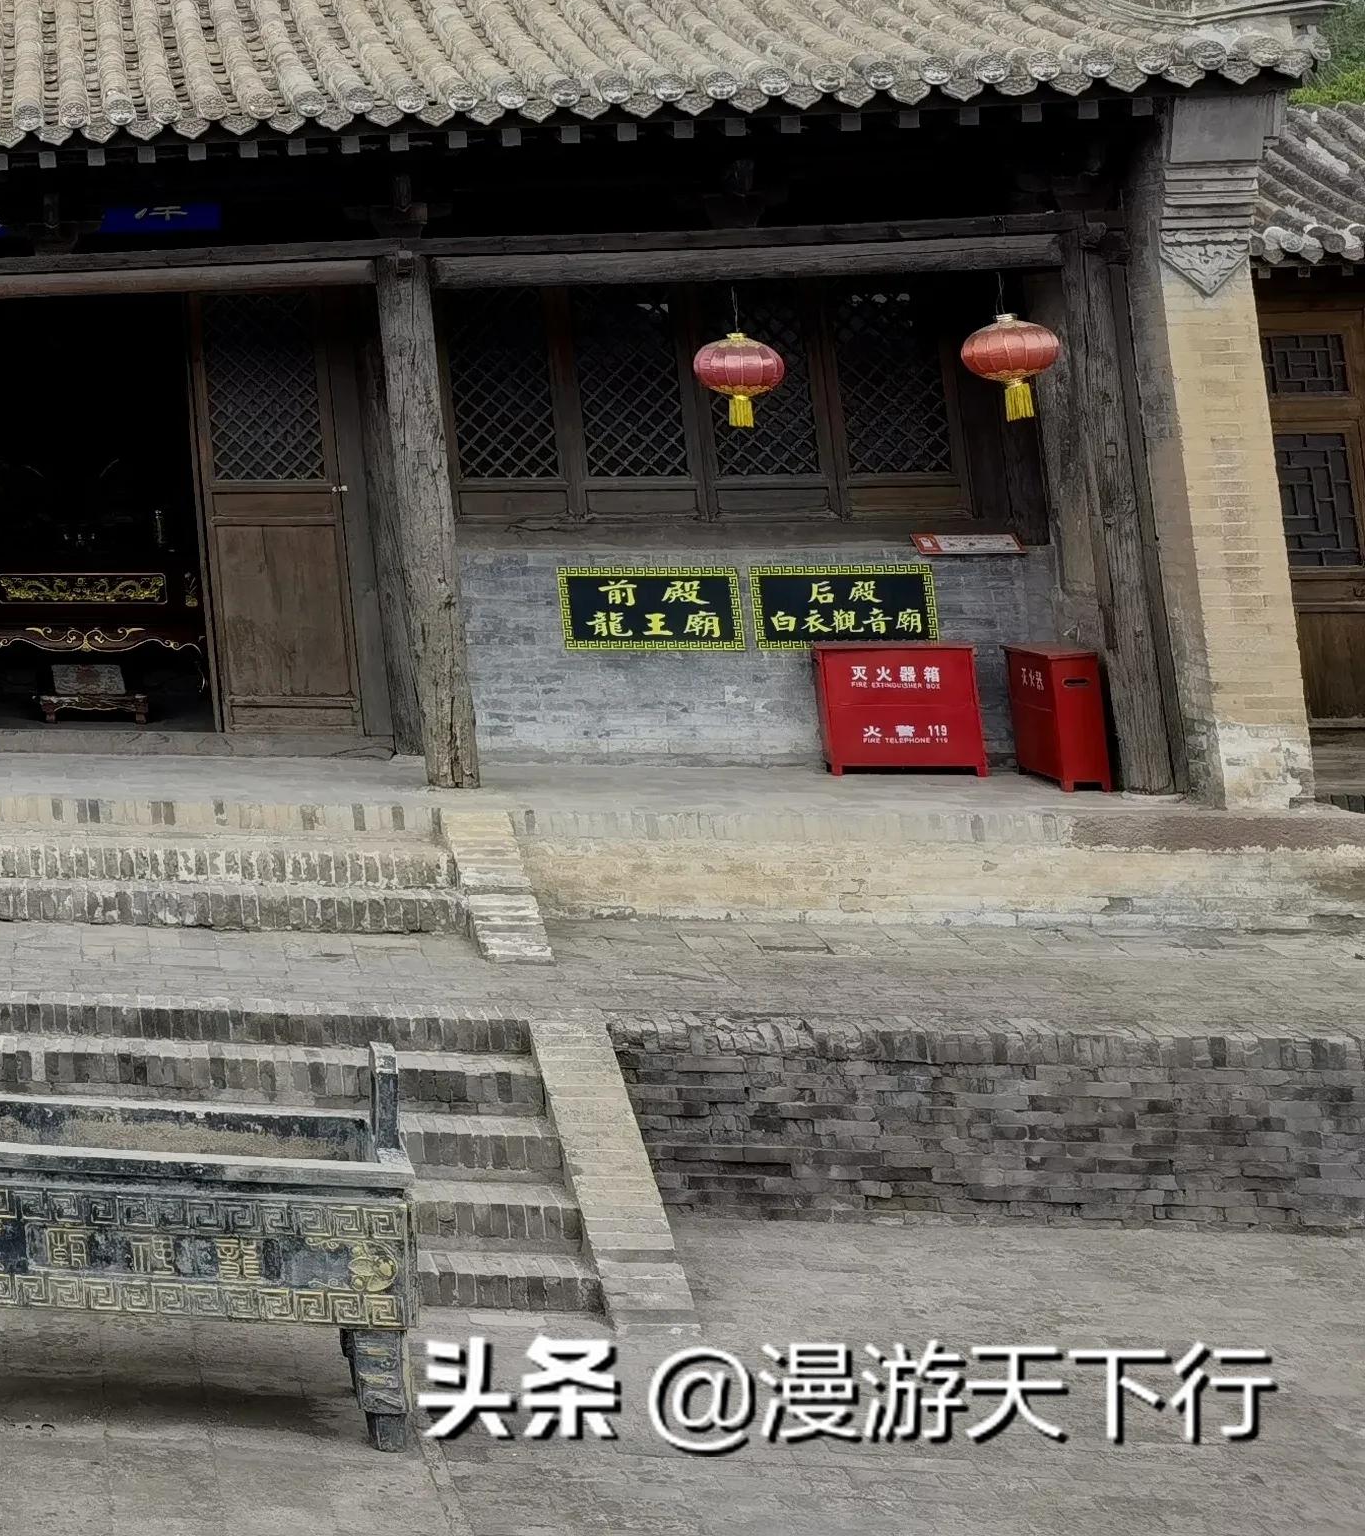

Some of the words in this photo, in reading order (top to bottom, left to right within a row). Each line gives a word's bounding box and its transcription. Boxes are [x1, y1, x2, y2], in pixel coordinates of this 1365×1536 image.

[597, 580, 710, 606] 前殿
[808, 580, 883, 604] 后殿
[585, 610, 722, 638] 龍王廟
[770, 610, 922, 634] 白衣觀音廟
[851, 666, 940, 682] 灭火器箱
